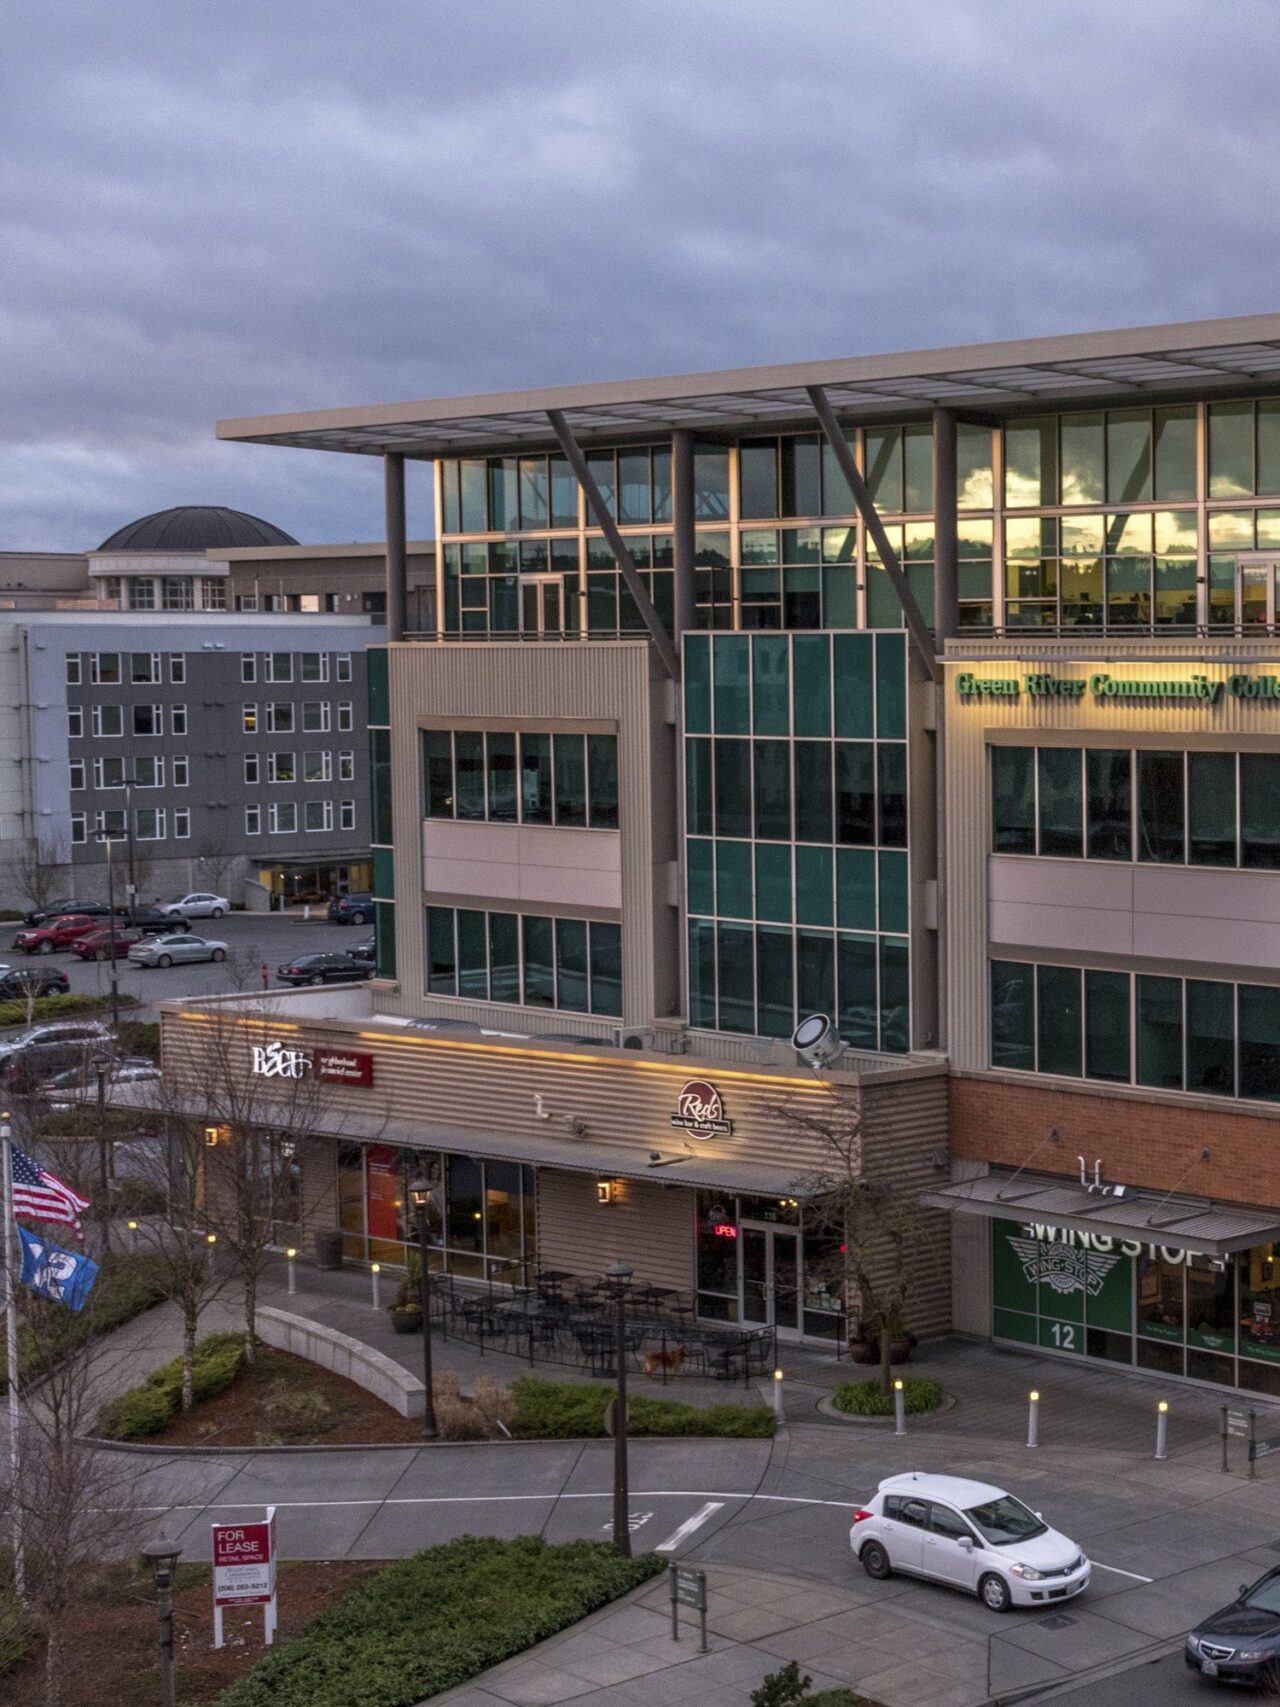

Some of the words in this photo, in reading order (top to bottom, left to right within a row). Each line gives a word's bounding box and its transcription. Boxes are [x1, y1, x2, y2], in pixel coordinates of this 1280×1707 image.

[955, 672, 1018, 695] Green
[1023, 674, 1084, 697] River
[1089, 673, 1219, 702] Community
[251, 1041, 313, 1079] BECU
[715, 1225, 737, 1237] OPEN
[1051, 1323, 1075, 1350] 12
[217, 1530, 245, 1541] FOR
[219, 1542, 259, 1553] LEASE
